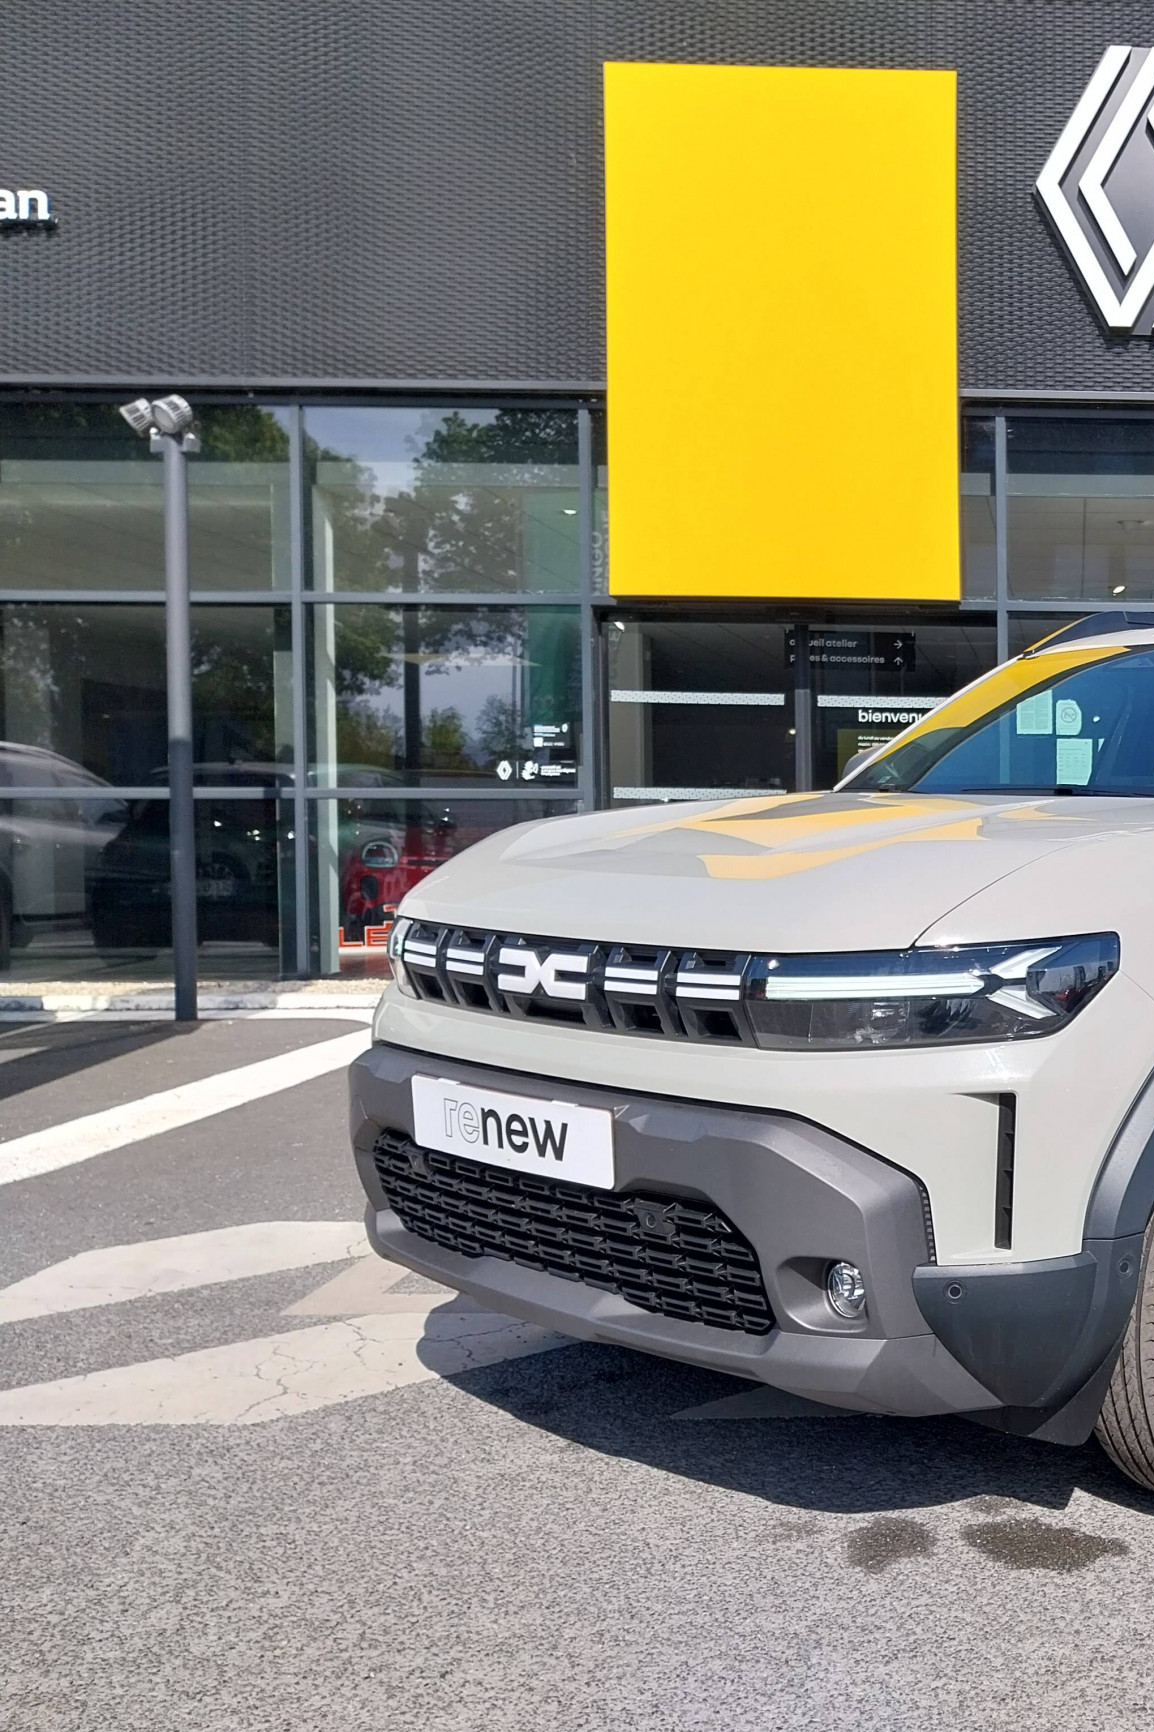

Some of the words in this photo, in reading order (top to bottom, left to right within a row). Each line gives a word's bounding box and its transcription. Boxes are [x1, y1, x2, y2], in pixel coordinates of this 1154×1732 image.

[826, 638, 857, 648] atelier
[829, 655, 885, 665] accessoires
[443, 1097, 569, 1162] renew
